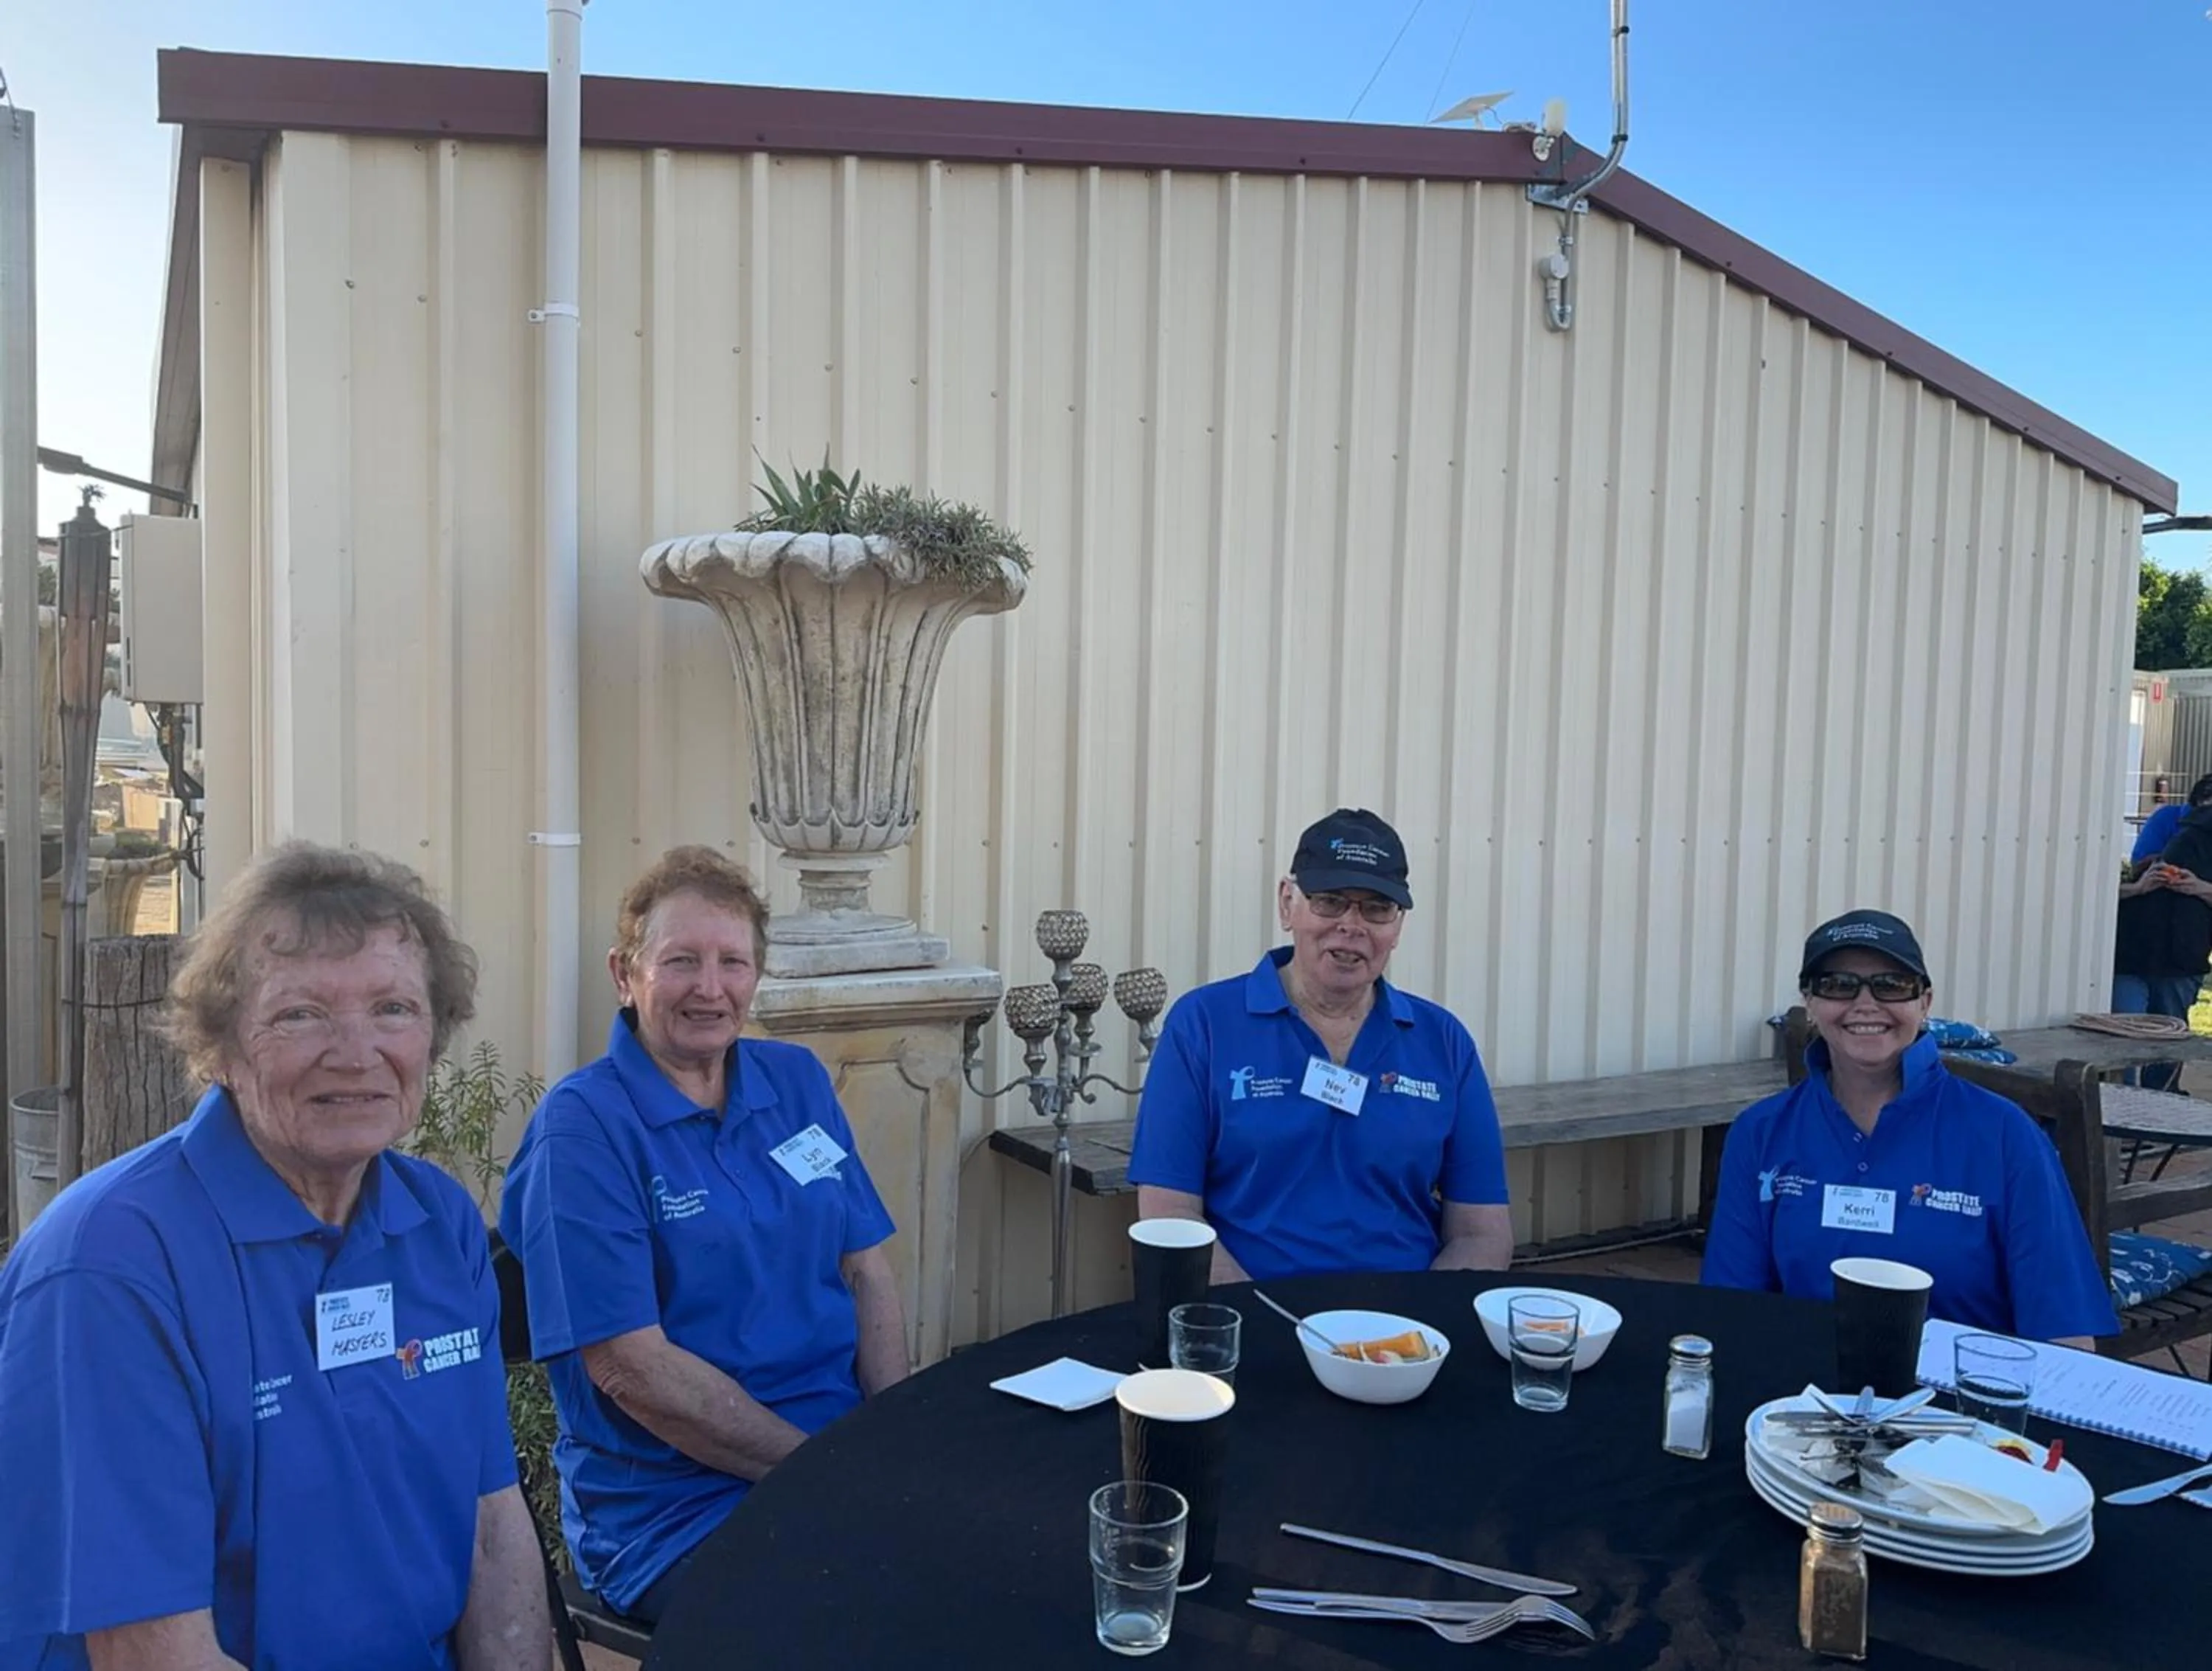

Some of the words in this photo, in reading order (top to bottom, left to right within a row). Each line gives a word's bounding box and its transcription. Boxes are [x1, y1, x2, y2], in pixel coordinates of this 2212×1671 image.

[1324, 1077, 1346, 1094] Nev
[1875, 1190, 1890, 1203] 78
[1844, 1203, 1875, 1217] Kerri
[331, 1309, 376, 1333] LESLEY
[331, 1330, 387, 1356] MASTERS
